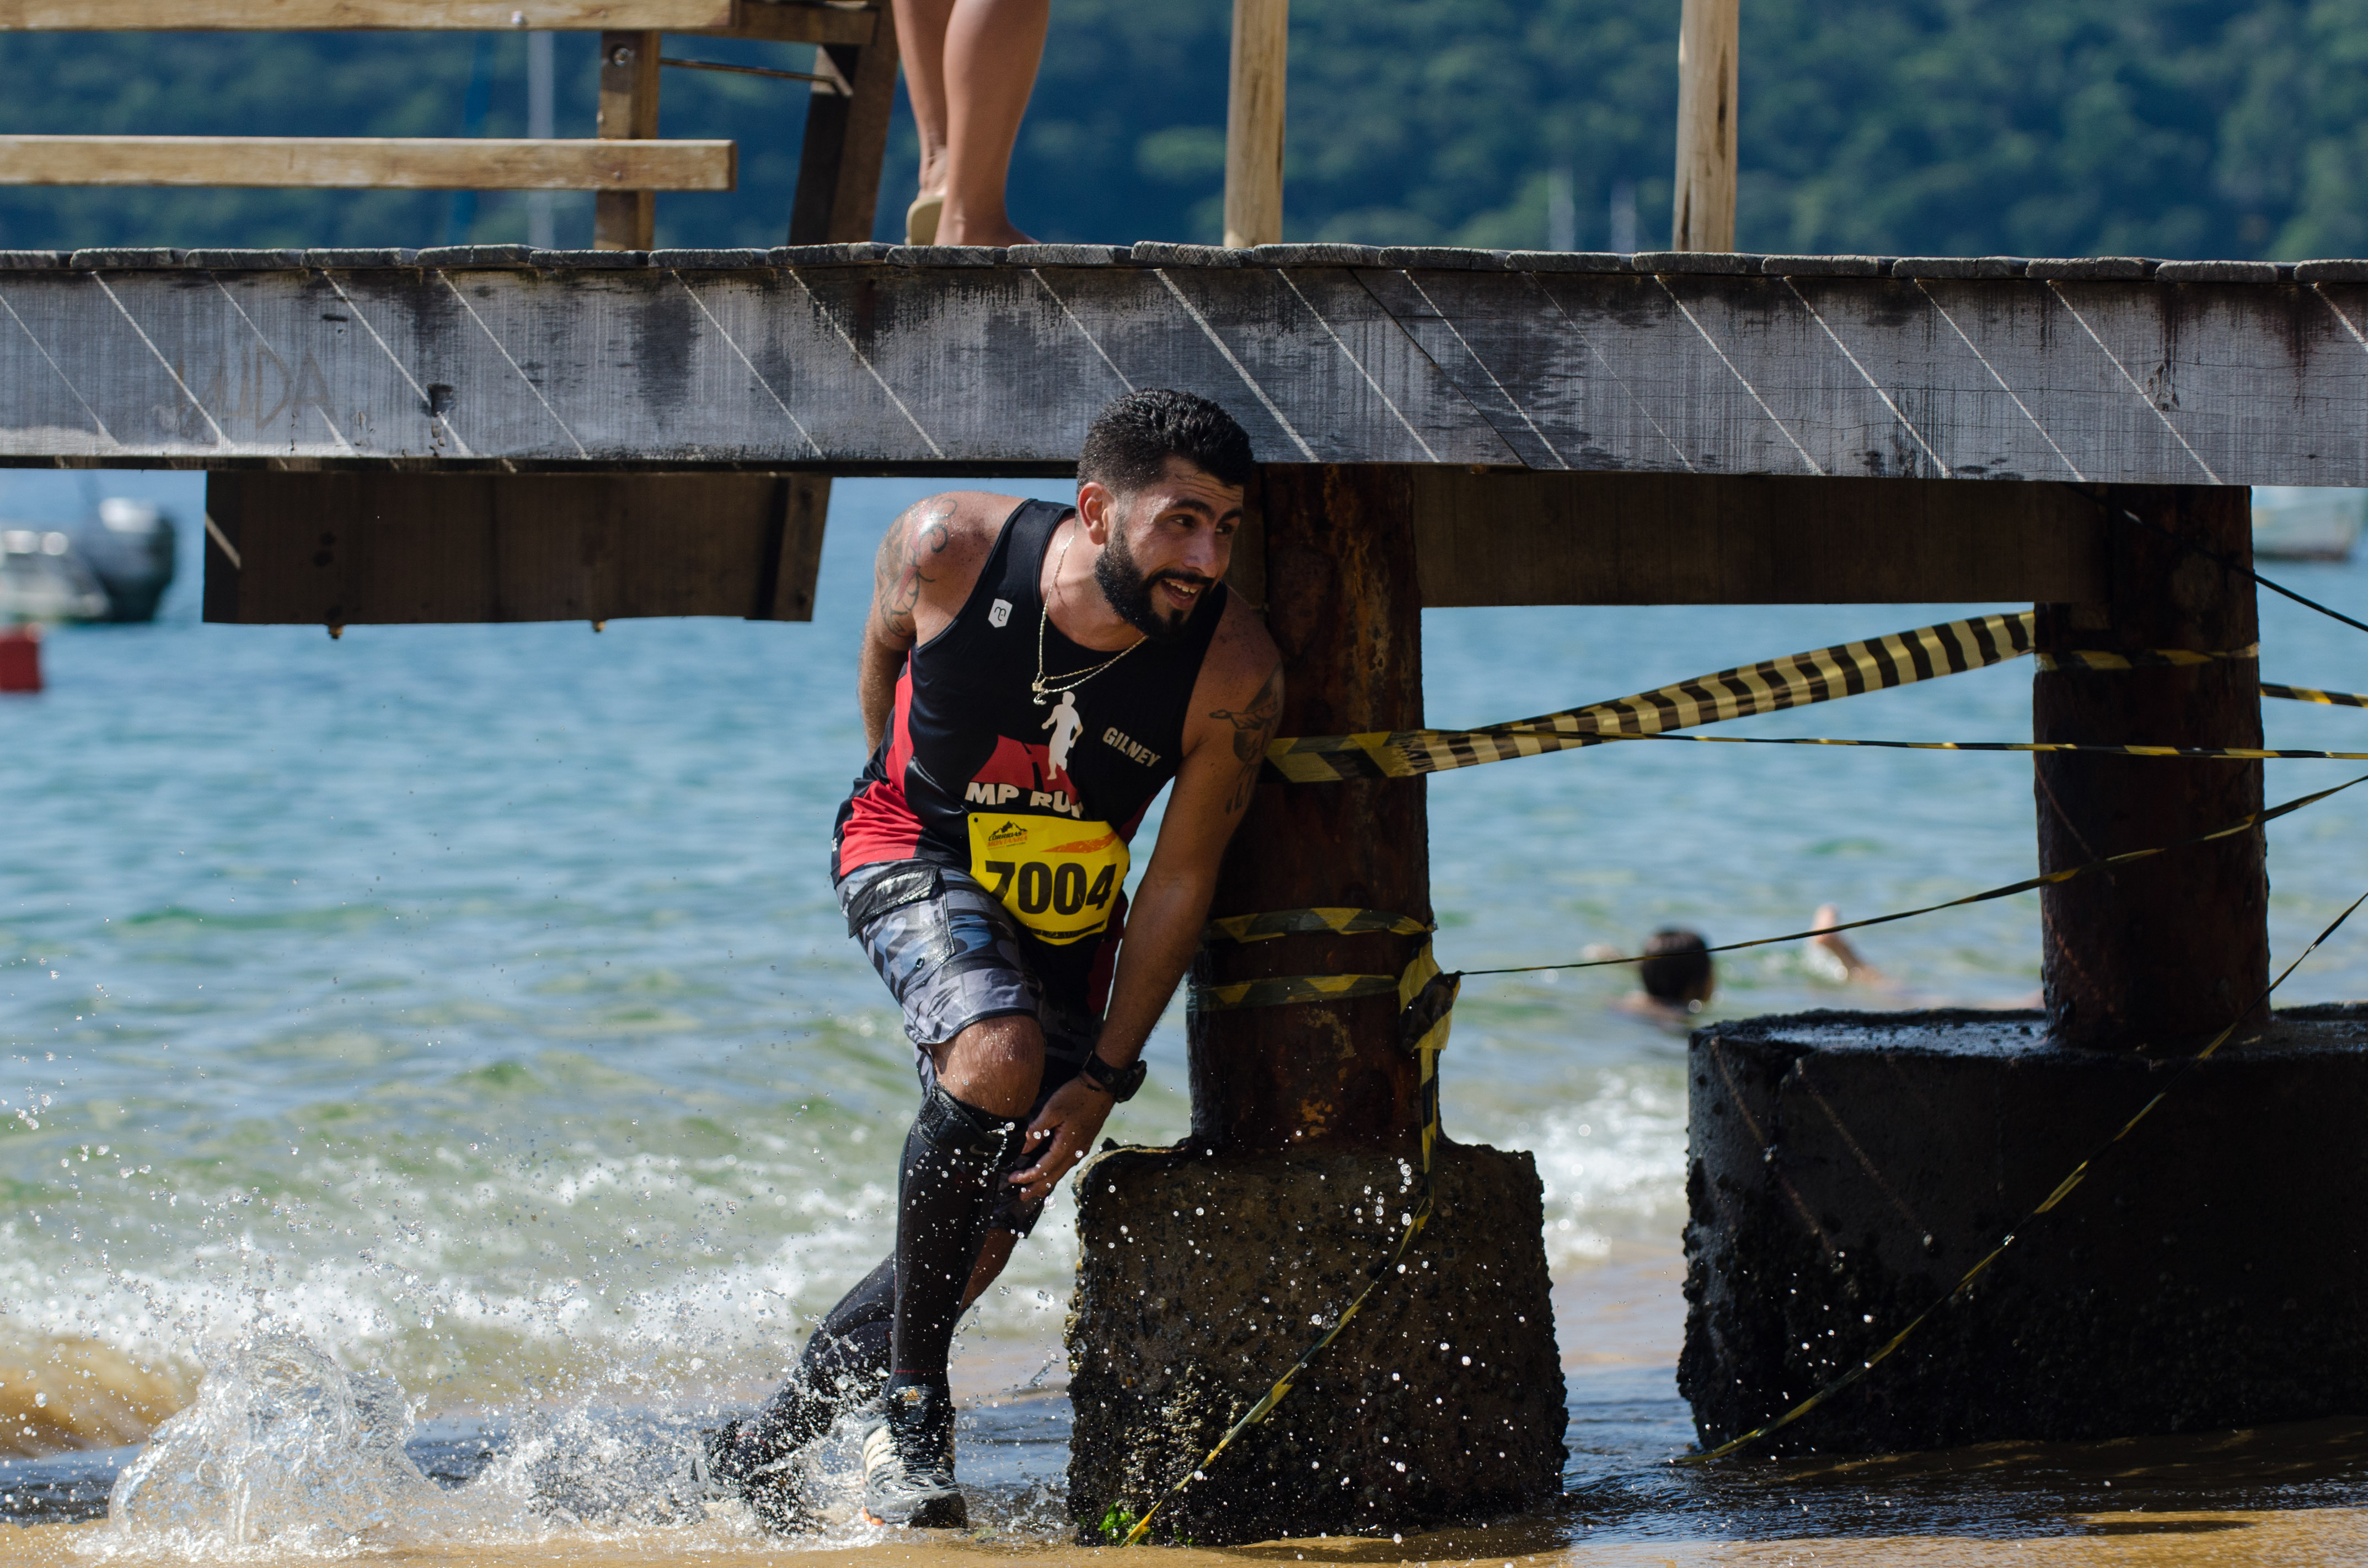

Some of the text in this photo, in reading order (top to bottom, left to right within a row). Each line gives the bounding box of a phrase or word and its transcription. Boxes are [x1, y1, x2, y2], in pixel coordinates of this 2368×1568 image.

[1102, 727, 1161, 767] GILNEY
[965, 782, 1020, 805] MP
[988, 831, 1022, 841] CORRIDAS
[985, 860, 1117, 915] 7004
